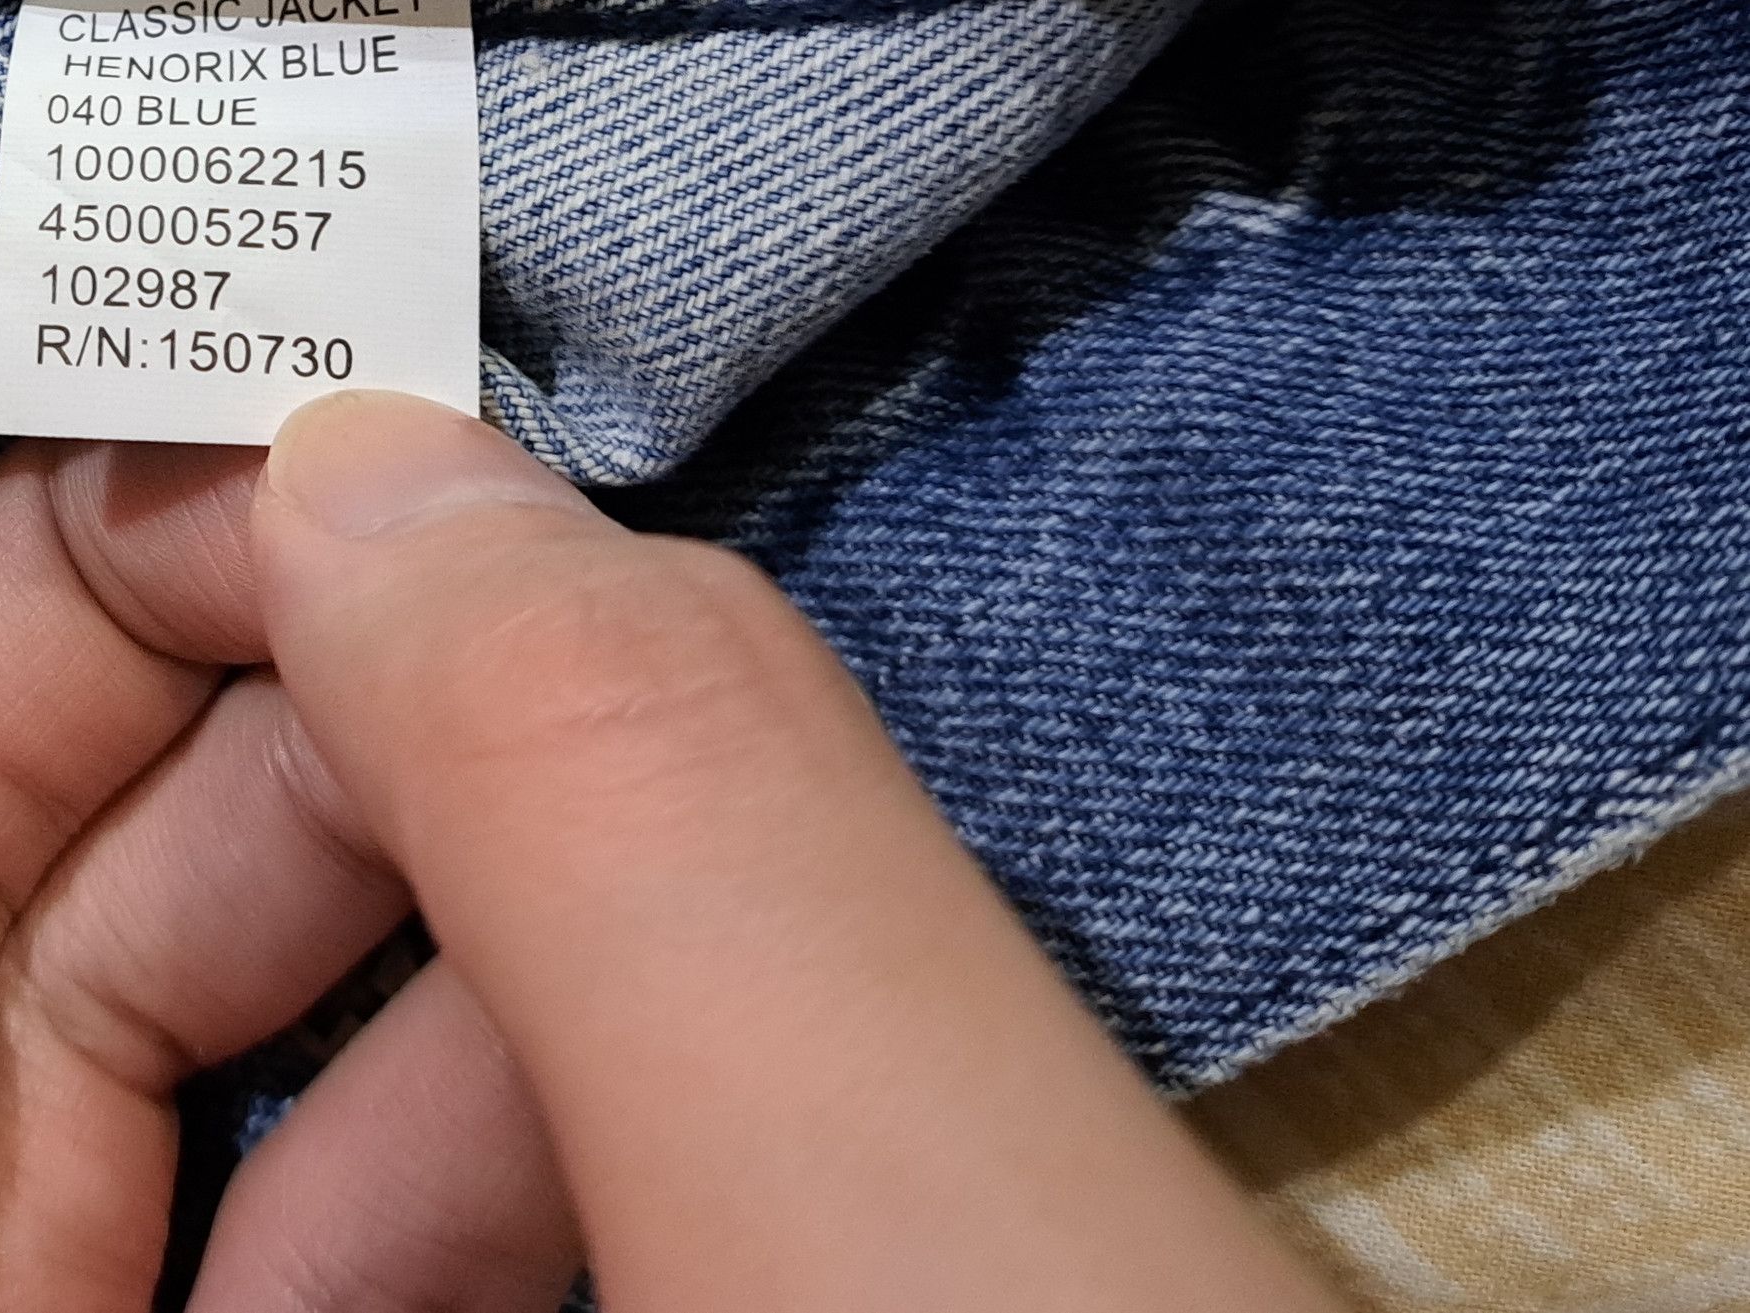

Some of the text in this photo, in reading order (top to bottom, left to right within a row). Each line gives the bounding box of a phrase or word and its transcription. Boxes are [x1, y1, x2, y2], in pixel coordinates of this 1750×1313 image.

[282, 34, 399, 80] BLUE
[47, 94, 257, 127] 040 BLUE
[47, 143, 366, 190] 1000062215
[38, 203, 332, 252] 450005257
[42, 264, 231, 311] 102987
[37, 324, 353, 380] R/N:150730
